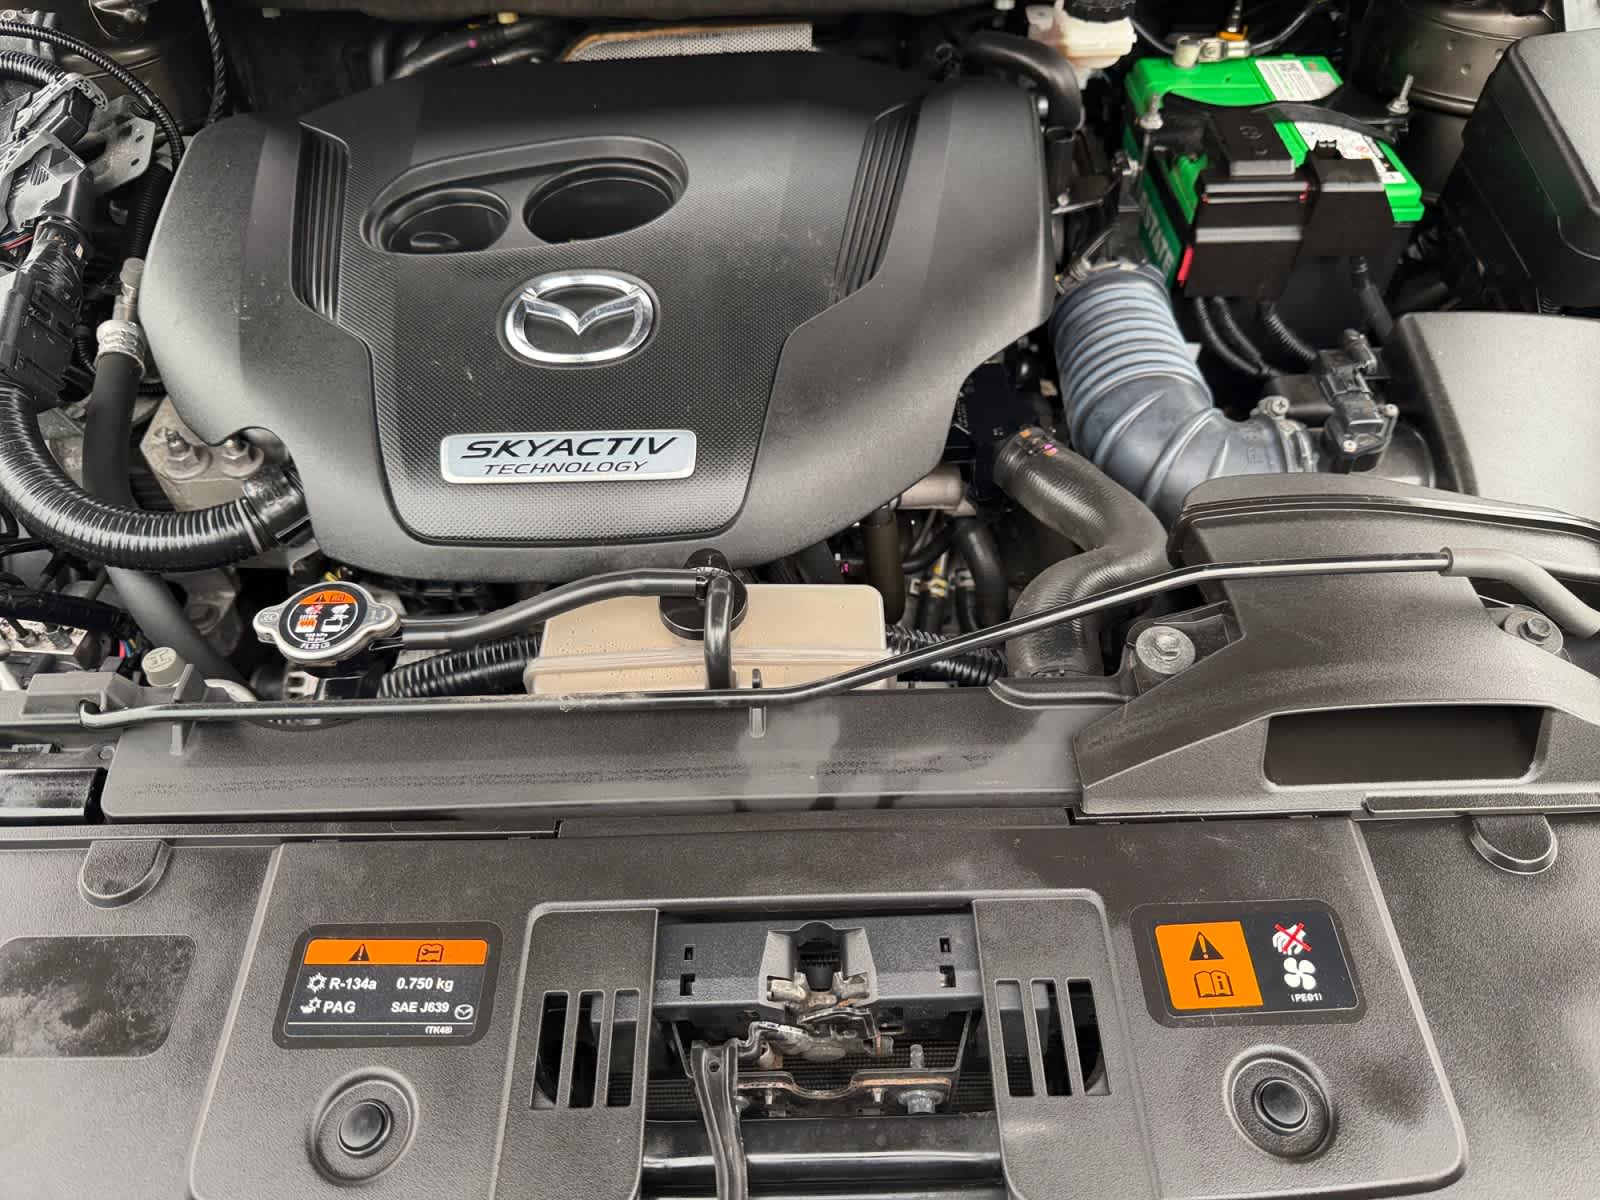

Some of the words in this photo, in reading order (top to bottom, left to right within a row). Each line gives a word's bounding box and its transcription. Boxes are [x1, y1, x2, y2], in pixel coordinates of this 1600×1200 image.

[460, 436, 679, 459] SKYACTIV
[483, 460, 649, 475] TECHNOLOGY
[329, 977, 377, 990] R-134a
[396, 977, 433, 990] 0.750
[436, 977, 454, 992] kg
[322, 1000, 356, 1014] PAG
[390, 1001, 417, 1013] SAE
[419, 1001, 450, 1013] J639
